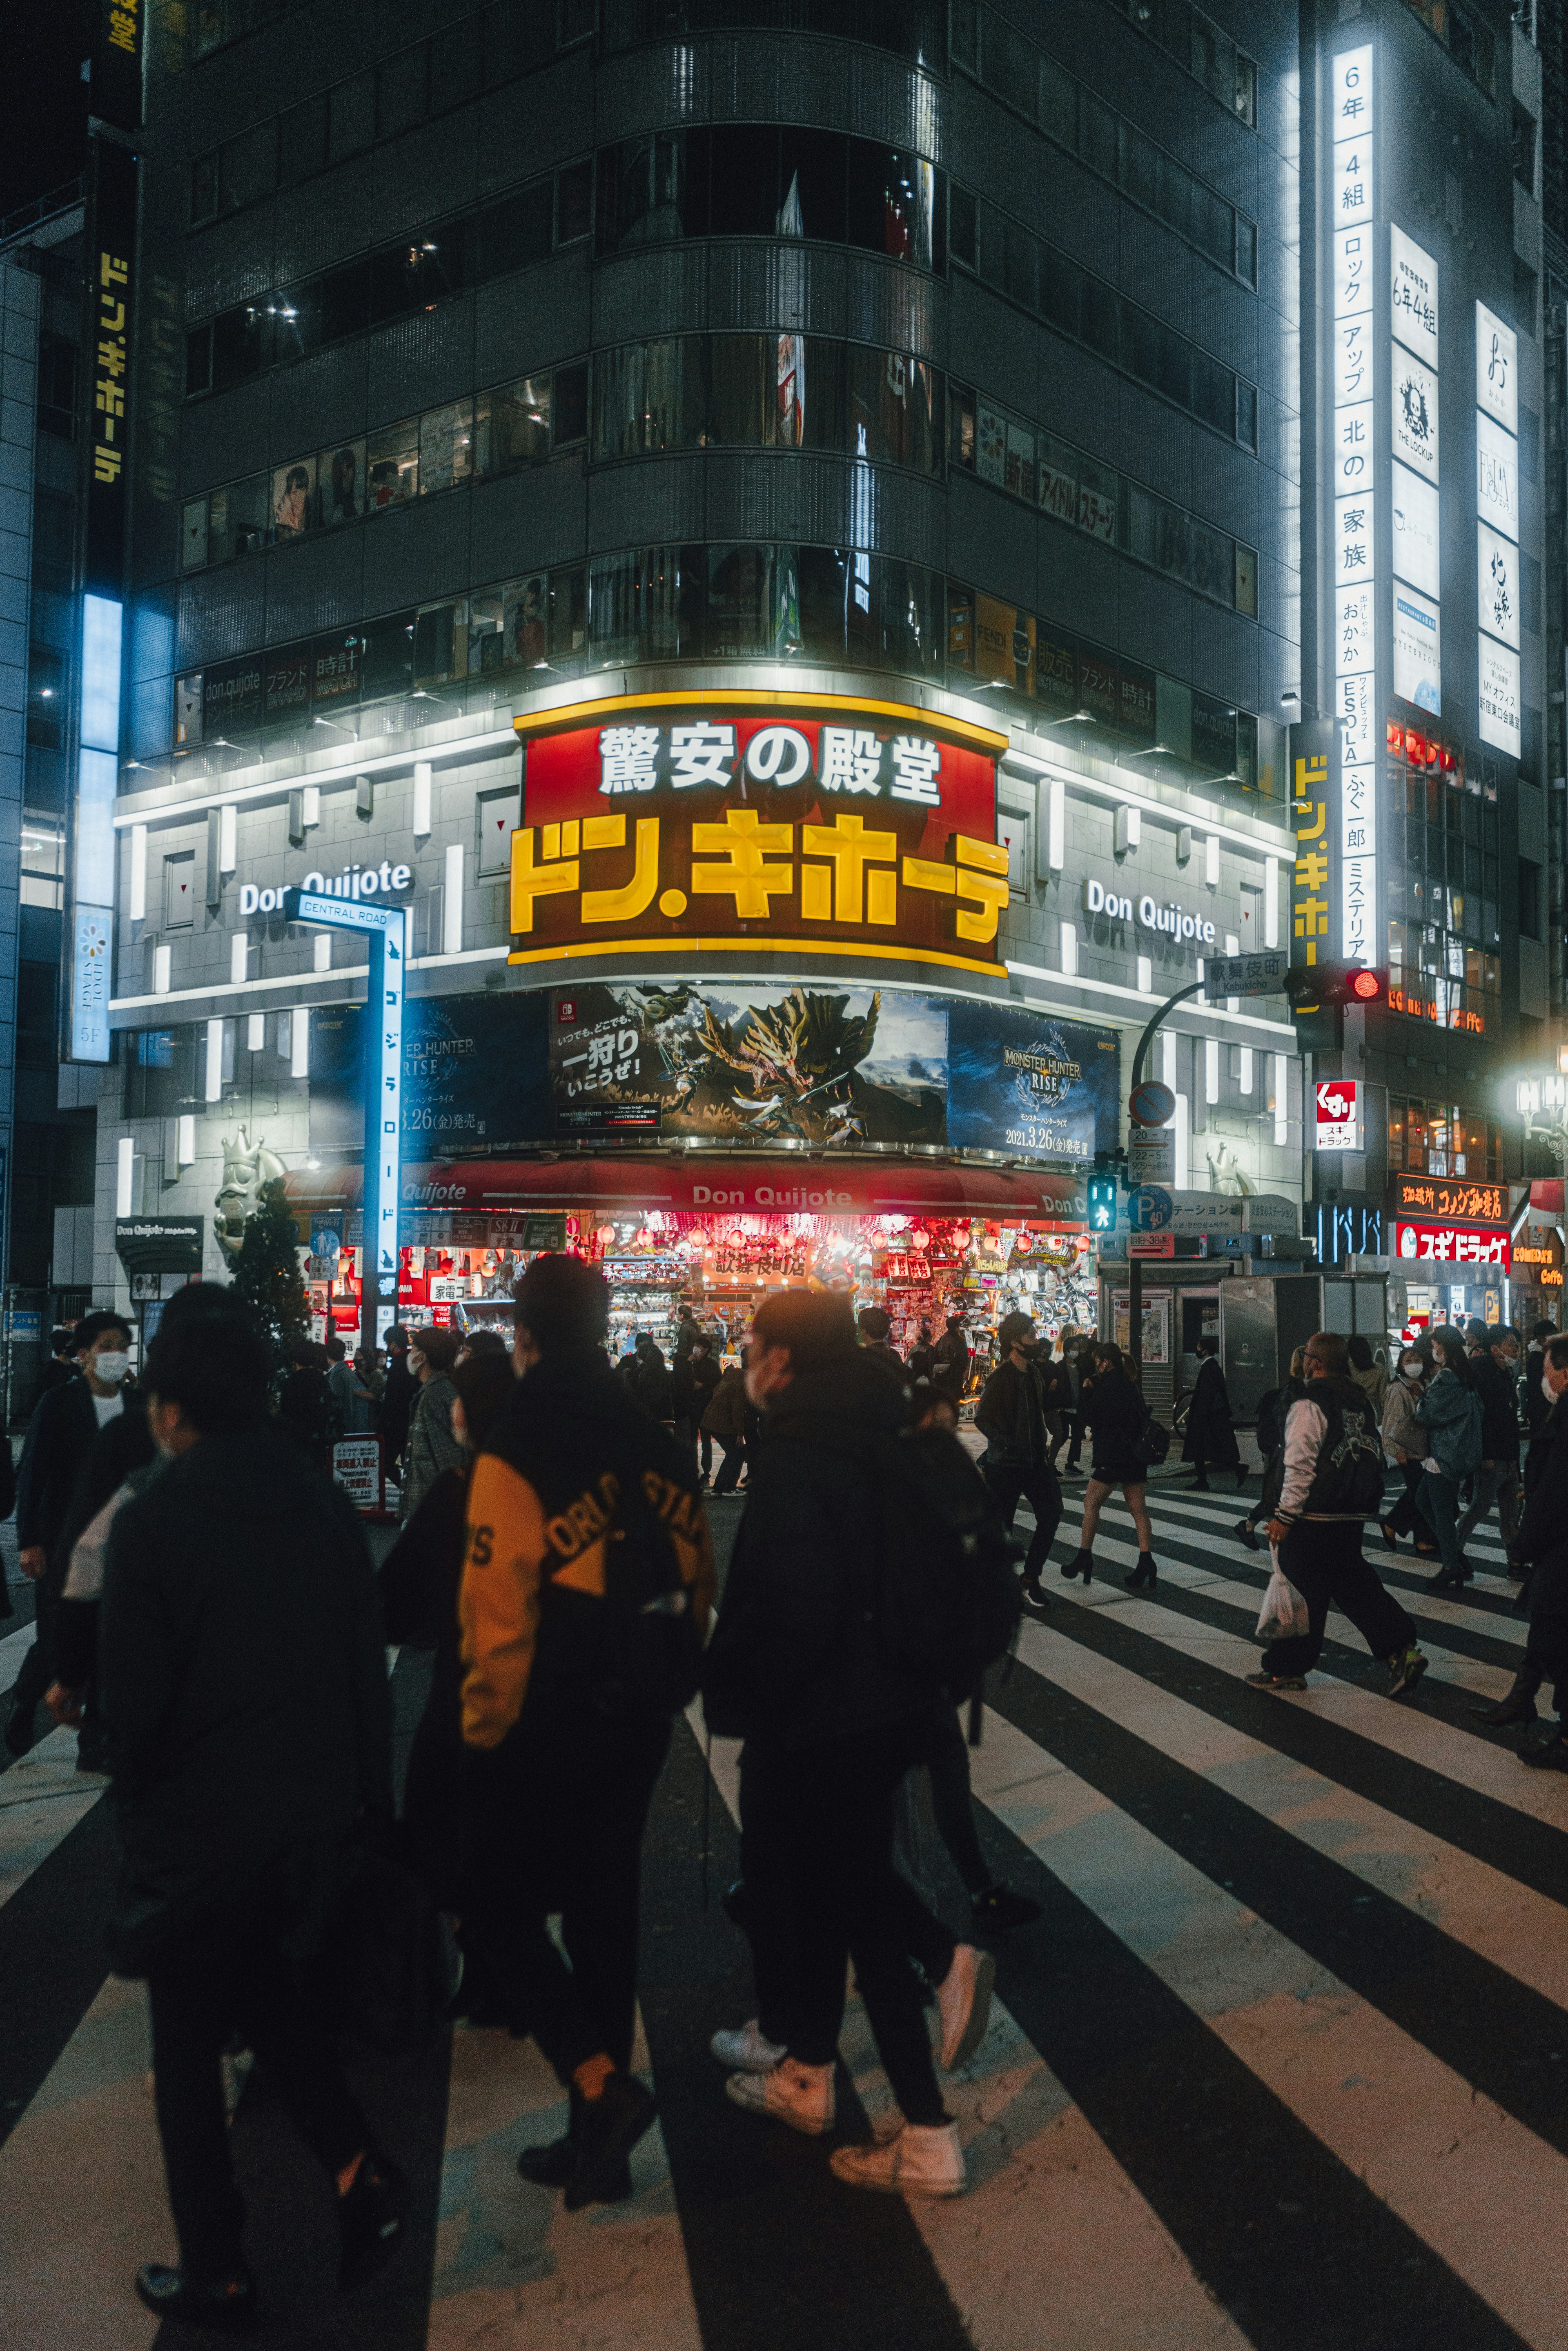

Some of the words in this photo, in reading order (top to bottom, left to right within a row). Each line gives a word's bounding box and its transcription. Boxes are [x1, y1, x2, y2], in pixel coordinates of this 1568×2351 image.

[1342, 67, 1365, 209] 6年4組
[1343, 237, 1364, 392] ロックアップ
[1393, 276, 1436, 336] 6年4組
[1398, 429, 1409, 446] THE
[1410, 439, 1433, 463] LOCKUP
[1041, 470, 1076, 520] アイドル
[1081, 493, 1114, 539] ステージ
[1343, 420, 1366, 569] 北の家族
[1359, 595, 1368, 637] 出汁しゃぶ
[1398, 602, 1422, 622] RESTAURANT
[1425, 617, 1435, 631] BAR
[978, 625, 1006, 649] FENDI
[1343, 604, 1359, 662] おかか
[316, 650, 359, 677] 時計
[1393, 637, 1441, 670] MYSTERIOUS
[205, 671, 261, 702] don.quijote
[267, 665, 307, 693] ブランド
[1082, 666, 1115, 694] ブランド
[1121, 681, 1154, 711] 時計
[1483, 679, 1492, 695] MY
[1493, 687, 1515, 709] オフィス
[1344, 682, 1357, 762] ESOLA
[1479, 695, 1520, 731] 新宿東口会議室
[598, 721, 942, 808] 驚安の殿堂
[1346, 774, 1365, 848] ふぐ一郎
[1295, 755, 1328, 1014] ドン・キホー
[304, 901, 355, 919] CENTRAL
[359, 911, 387, 925] ROAD
[1087, 879, 1132, 921] Don
[1139, 895, 1216, 944] Quijote
[93, 963, 102, 1003] IDOL
[1210, 959, 1280, 982] 歌舞伎町
[82, 961, 92, 1012] STAGE
[1224, 981, 1267, 992] Kabukicho
[80, 1026, 101, 1043] 5F
[558, 1015, 631, 1047] いつでも、どこでも、
[425, 1038, 473, 1056] HUNTER
[562, 1029, 639, 1069] 一狩り
[1098, 1041, 1116, 1052] CAPCOM
[403, 1059, 437, 1077] RISE
[568, 1059, 641, 1097] いこうぜ！
[1005, 1050, 1046, 1073] MONSTER
[1047, 1058, 1081, 1080] HUNTER
[1031, 1073, 1058, 1092] RISE
[382, 990, 401, 1221] ゴジラロード
[1317, 1082, 1356, 1122] くすり
[1020, 1112, 1067, 1128] モンスターハンターライズ
[1326, 1125, 1348, 1135] スギ
[1006, 1126, 1080, 1155] 2021.3.26(金)発売
[1319, 1135, 1355, 1146] ドラッグ
[401, 1182, 466, 1204] Quijote
[693, 1186, 744, 1205] Don
[755, 1186, 852, 1210] Quijote
[1042, 1195, 1073, 1213] Don
[1402, 1186, 1434, 1209] 珈琲所
[1438, 1188, 1501, 1220] コメダ珈琲店
[1138, 1196, 1155, 1224] P
[1150, 1212, 1163, 1222] 40
[1251, 1204, 1294, 1219] 安全安心ステーション
[117, 1226, 133, 1235] Don
[134, 1225, 163, 1237] Quijote
[1054, 1238, 1061, 1246] 祭
[715, 1248, 806, 1277] 歌舞伎町店
[1487, 1296, 1493, 1321] P
